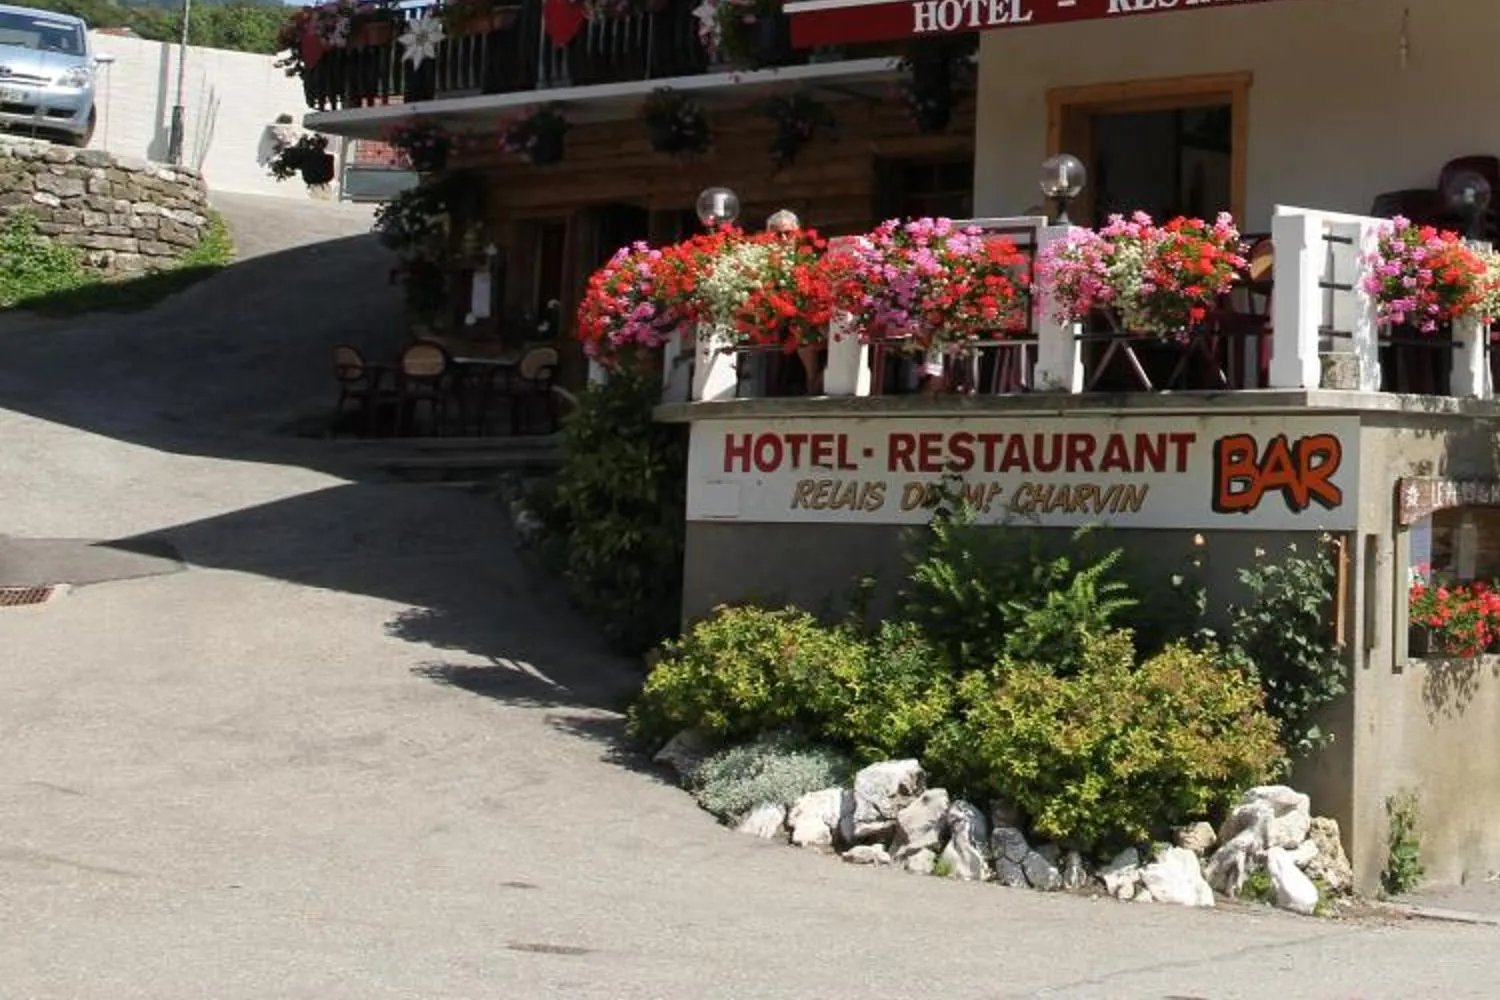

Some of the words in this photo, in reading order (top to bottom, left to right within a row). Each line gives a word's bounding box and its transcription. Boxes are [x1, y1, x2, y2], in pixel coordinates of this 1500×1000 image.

[887, 432, 1197, 474] RESTAURANT
[1211, 432, 1343, 515] BAR
[790, 479, 887, 512] RELAIS
[1011, 480, 1149, 514] CHARVIN
